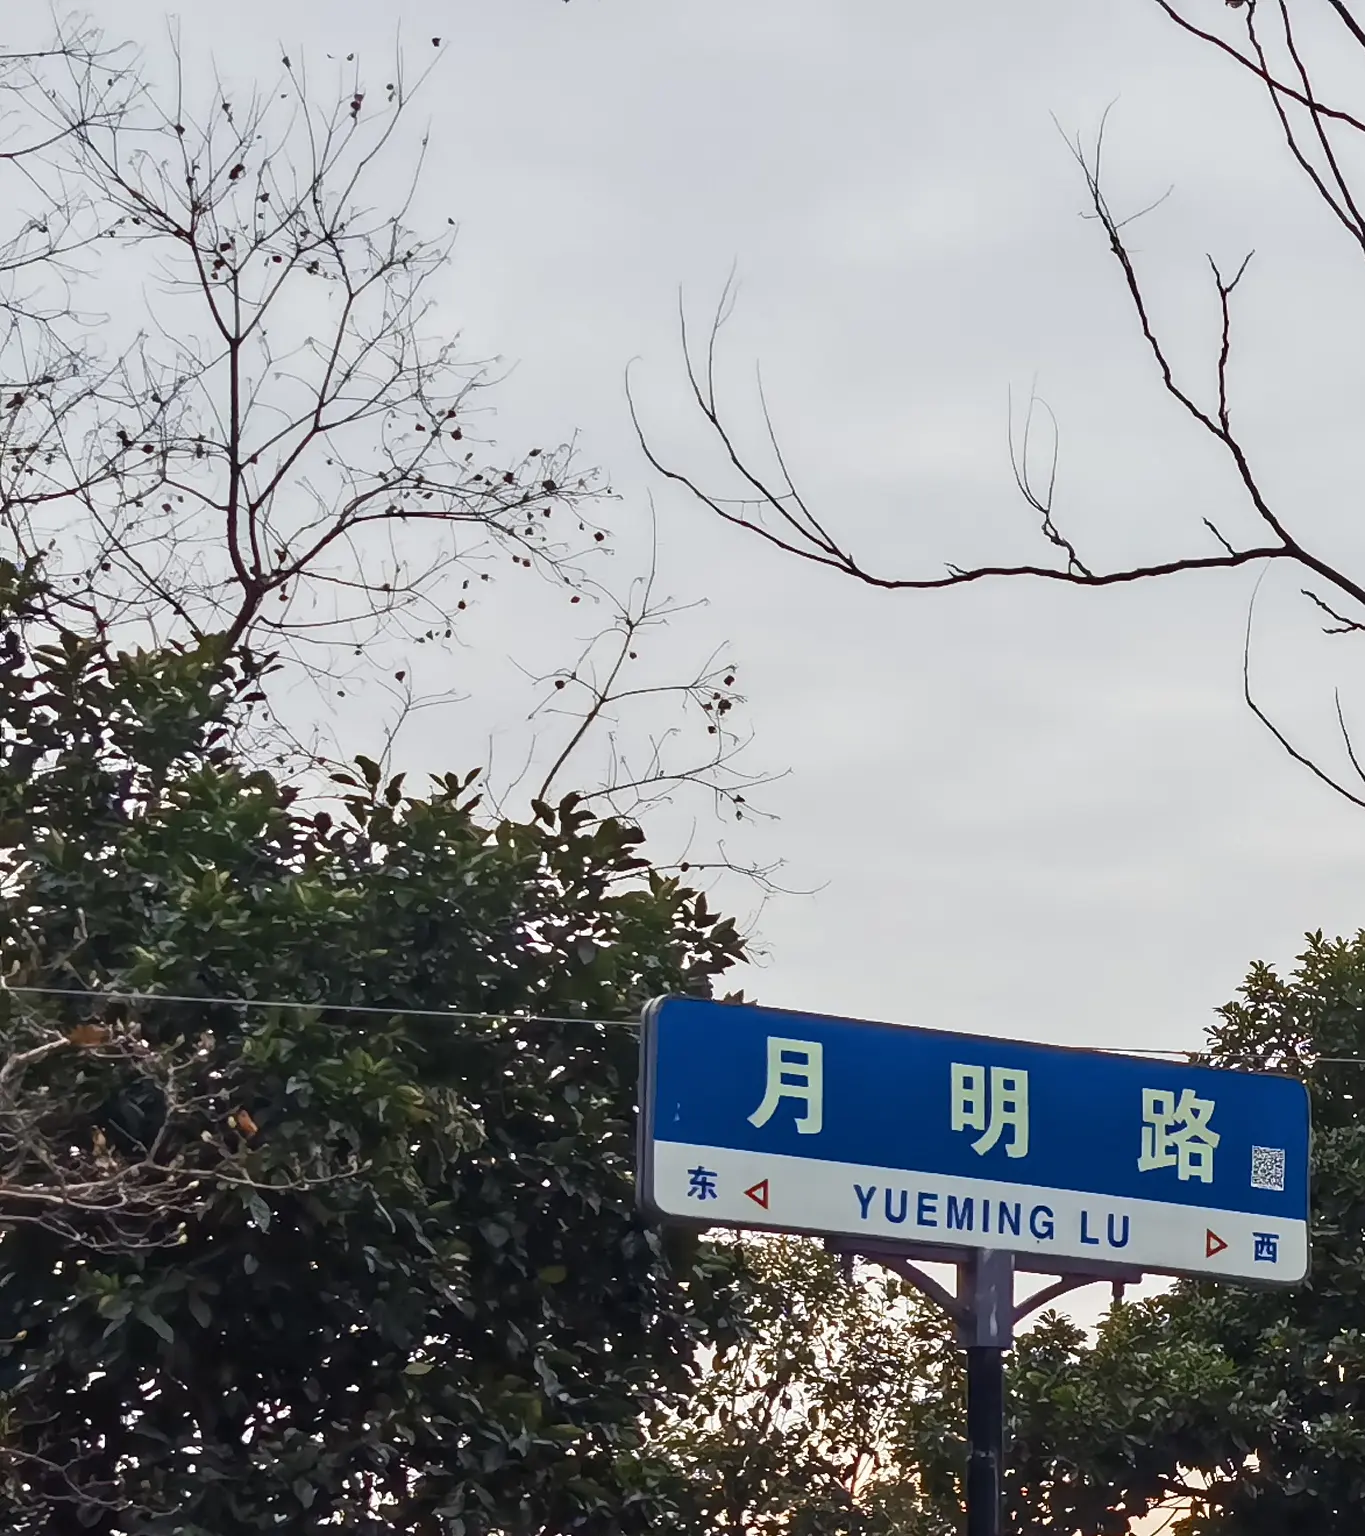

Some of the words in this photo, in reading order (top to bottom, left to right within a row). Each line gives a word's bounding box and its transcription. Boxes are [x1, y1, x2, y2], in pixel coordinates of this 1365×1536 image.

[747, 1036, 1221, 1184] 月明路
[687, 1165, 718, 1201] 东
[853, 1184, 1055, 1241] YUEMING
[1079, 1210, 1130, 1249] LU
[1252, 1231, 1280, 1264] 西
